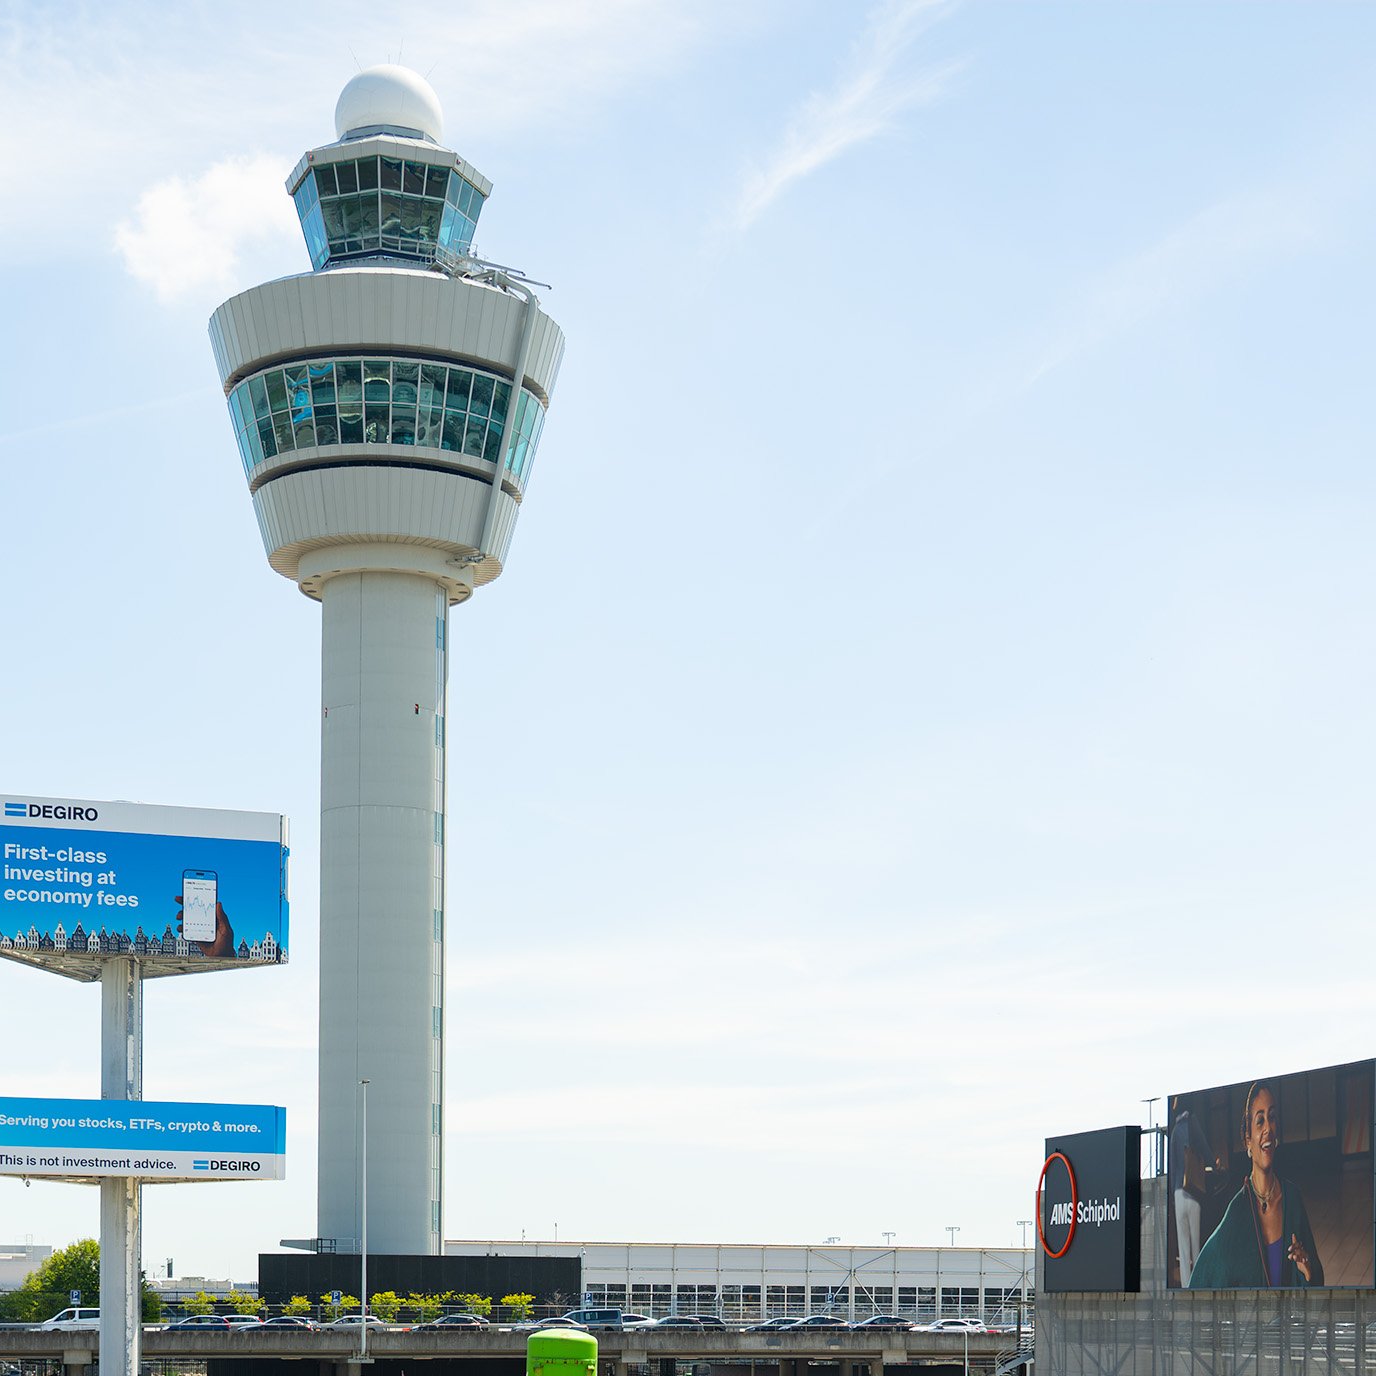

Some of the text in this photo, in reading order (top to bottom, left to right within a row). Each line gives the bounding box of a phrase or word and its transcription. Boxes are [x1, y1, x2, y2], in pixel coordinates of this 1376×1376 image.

[29, 804, 98, 821] DEGIRO
[4, 843, 107, 864] First-class
[4, 865, 116, 887] investing at
[4, 888, 139, 908] economy fees
[51, 1119, 76, 1129] you
[78, 1117, 126, 1131] stocks,
[129, 1118, 165, 1132] ETFs,
[167, 1121, 210, 1133] crypto
[212, 1121, 222, 1132] &
[224, 1123, 262, 1133] more.
[26, 1155, 36, 1166] is
[39, 1156, 60, 1167] not
[62, 1156, 131, 1169] investment
[133, 1158, 177, 1170] advice.
[210, 1160, 261, 1172] DEGIRO
[1050, 1197, 1120, 1227] AMS Schiphol
